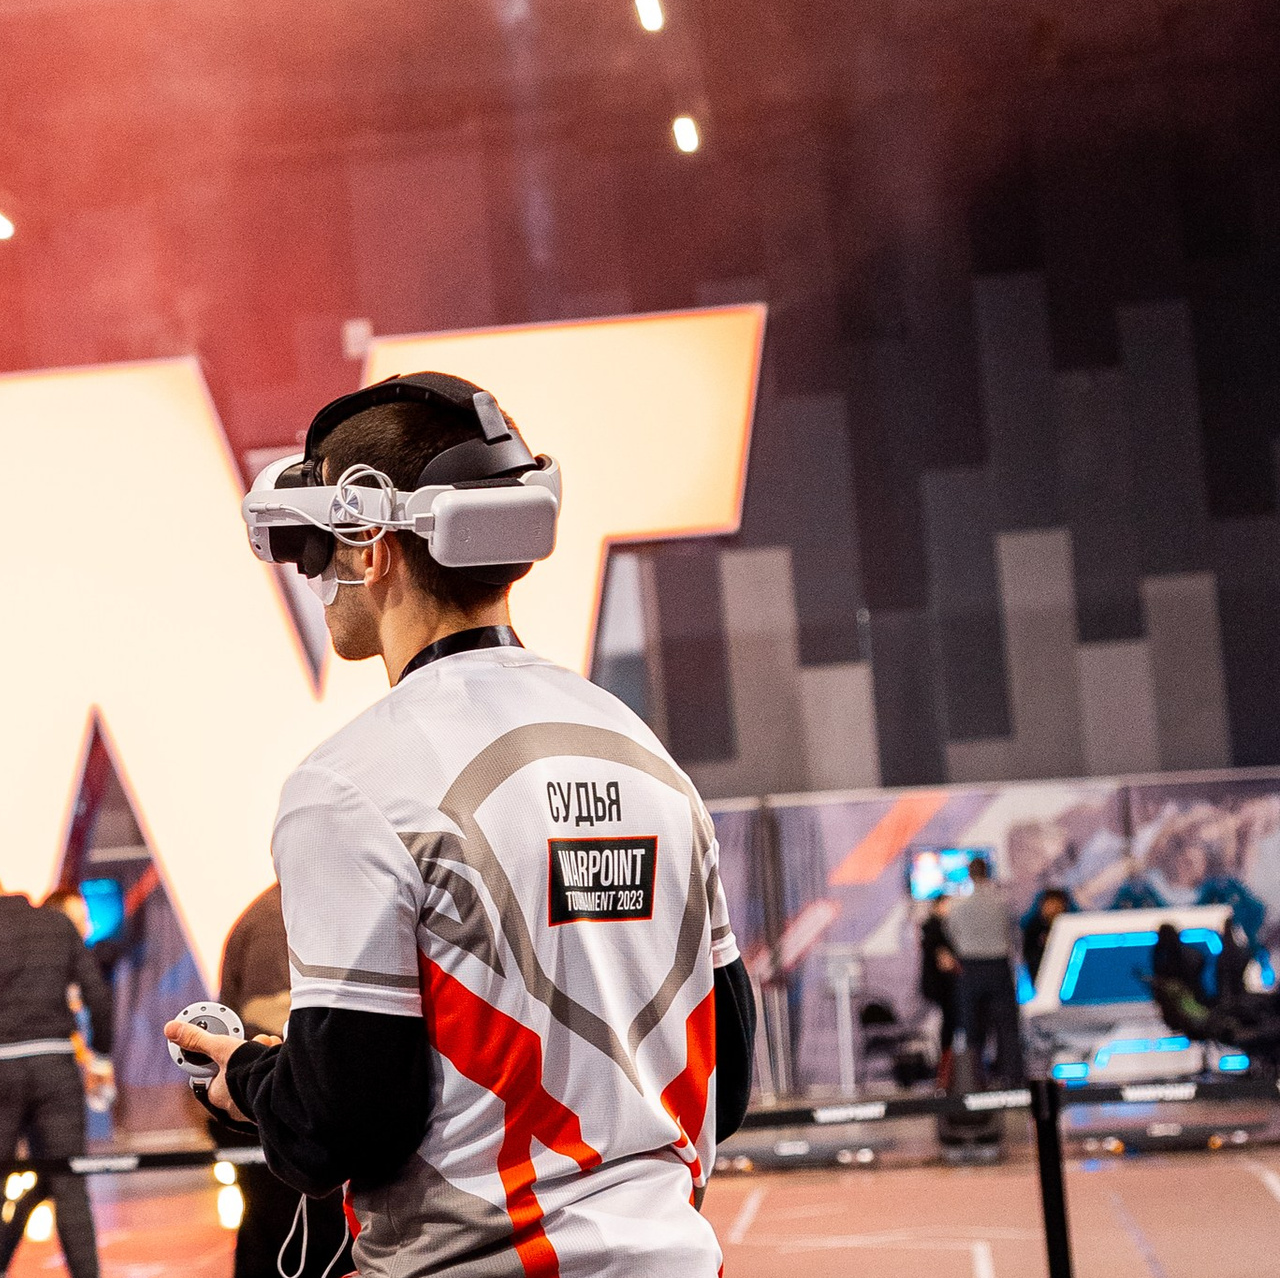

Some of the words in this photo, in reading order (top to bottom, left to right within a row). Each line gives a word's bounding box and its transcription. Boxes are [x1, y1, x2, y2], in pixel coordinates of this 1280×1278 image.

[547, 781, 622, 827] СУДЬЯ
[557, 848, 646, 887] WARPOINT
[565, 890, 616, 912] TOAMENT
[616, 889, 644, 911] 2023
